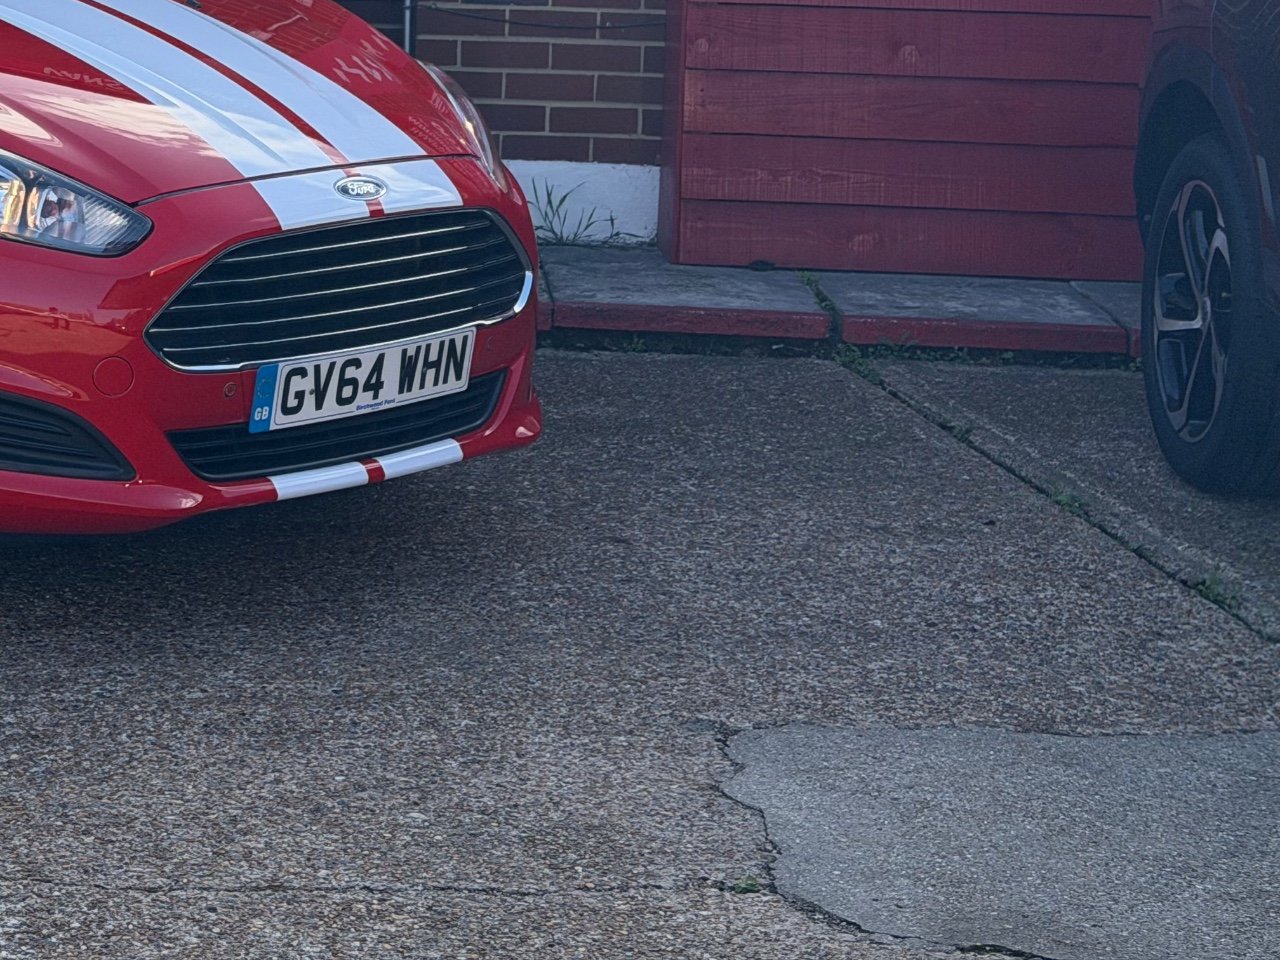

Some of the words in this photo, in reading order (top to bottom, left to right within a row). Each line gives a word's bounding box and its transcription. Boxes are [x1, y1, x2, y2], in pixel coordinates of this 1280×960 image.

[280, 352, 386, 416] GV64
[398, 334, 469, 395] WHN
[254, 406, 269, 421] GB
